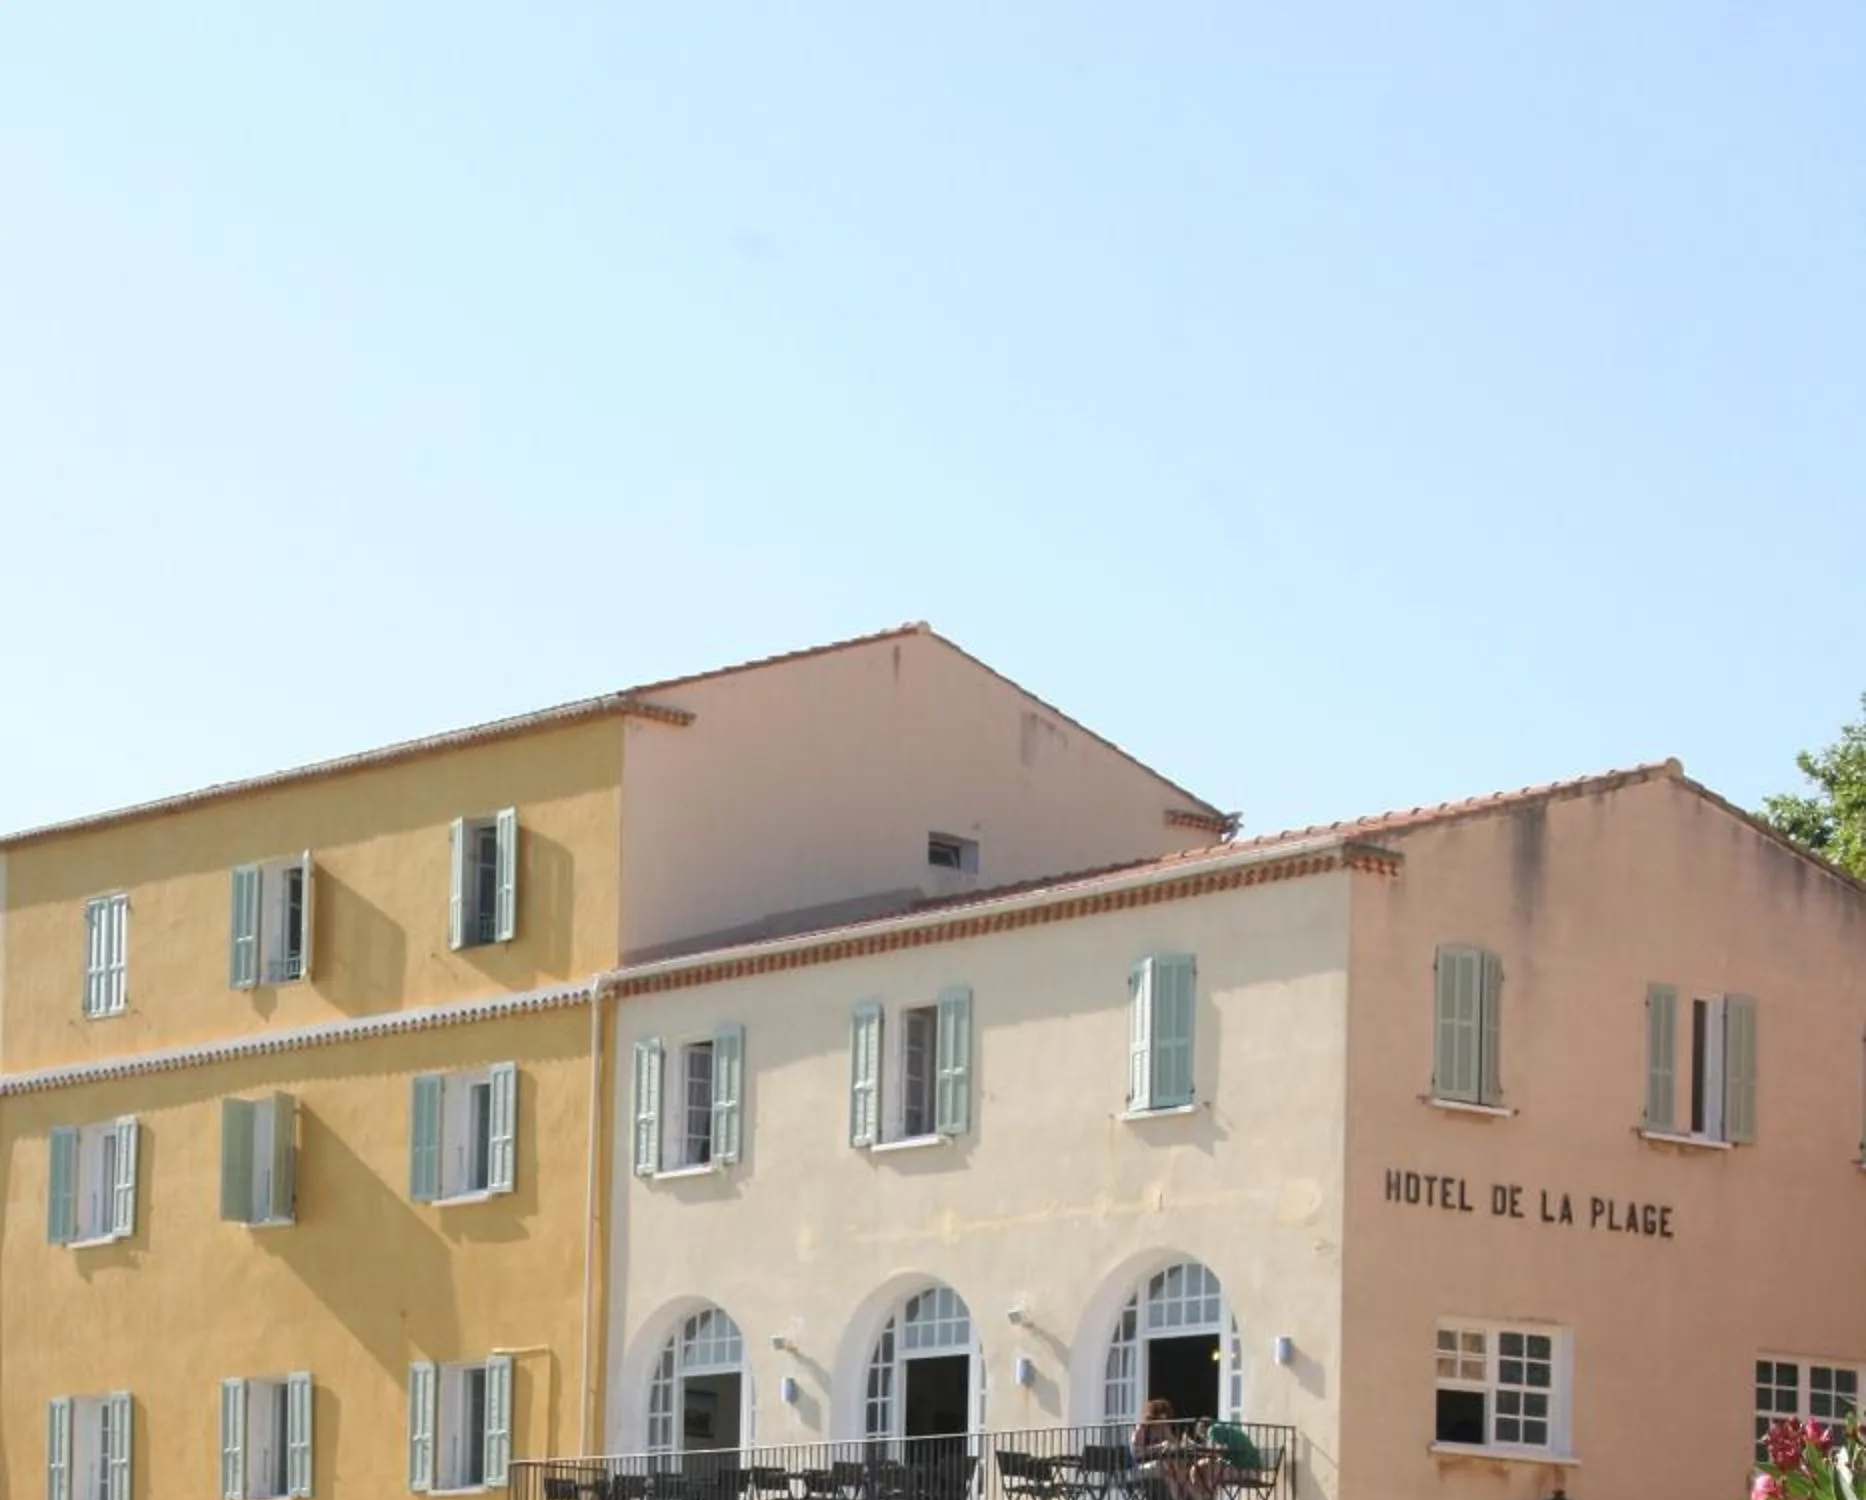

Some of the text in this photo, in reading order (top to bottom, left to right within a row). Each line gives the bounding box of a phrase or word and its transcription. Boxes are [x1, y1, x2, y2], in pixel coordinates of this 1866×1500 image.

[1385, 1168, 1674, 1238] HOTEL DE LA PLAGE
